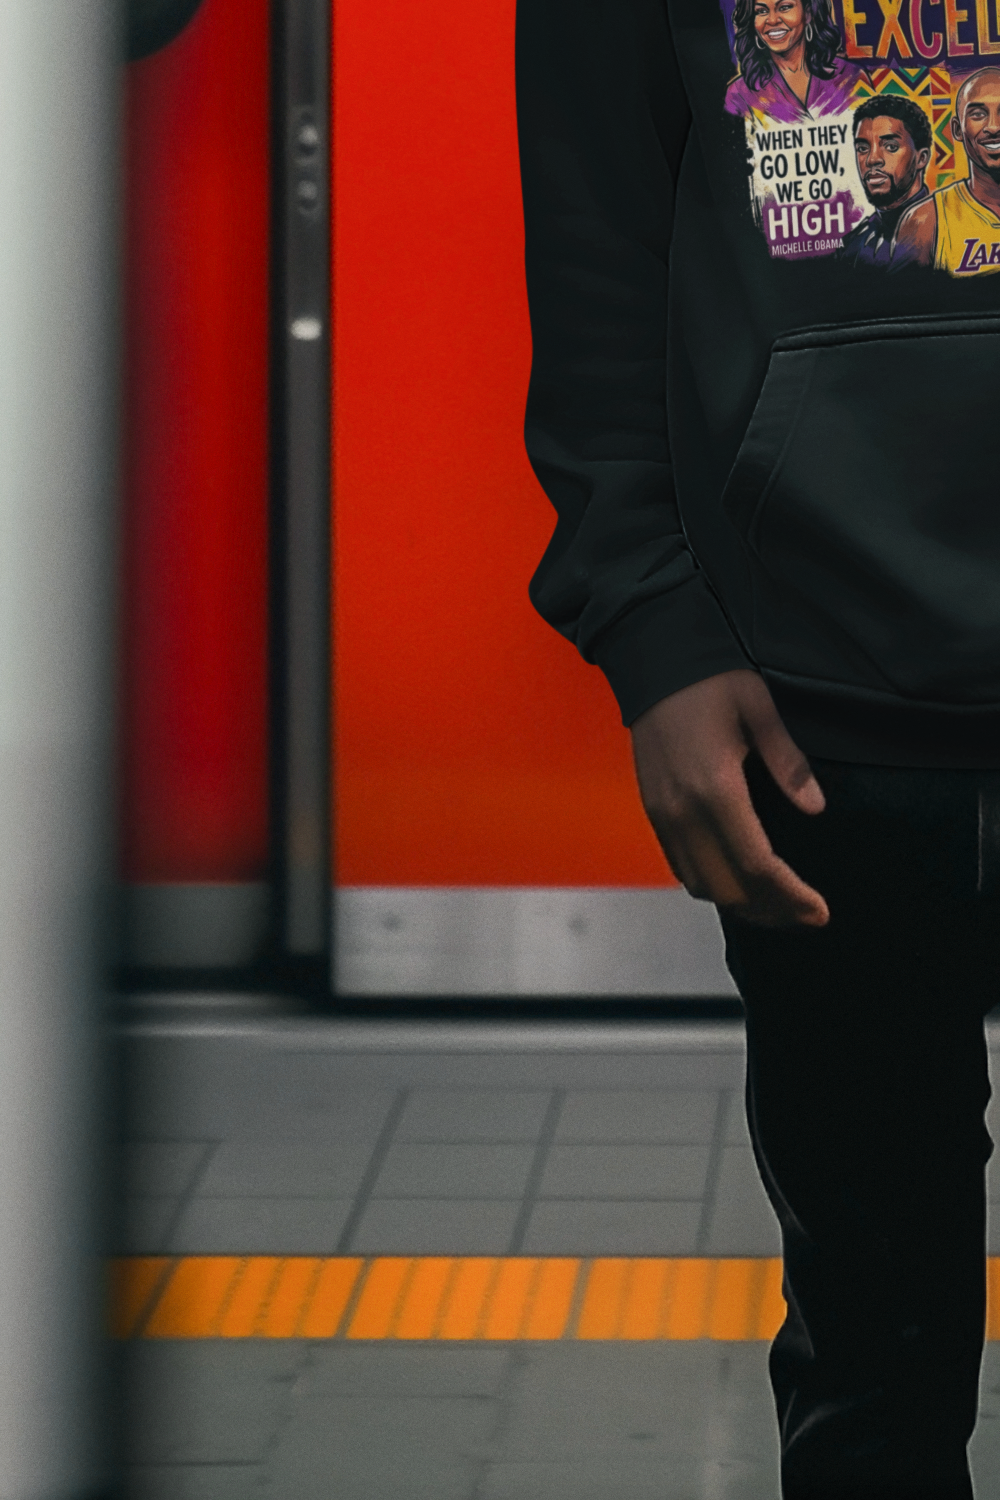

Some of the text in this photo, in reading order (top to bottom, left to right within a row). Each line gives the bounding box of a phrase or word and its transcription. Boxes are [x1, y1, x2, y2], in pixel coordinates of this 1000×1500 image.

[756, 124, 847, 151] WHEN THEY
[760, 150, 844, 179] GO LOW,
[776, 178, 832, 203] WE GO
[768, 202, 844, 240] HIGH
[772, 238, 844, 256] MICHELLE OBAMA
